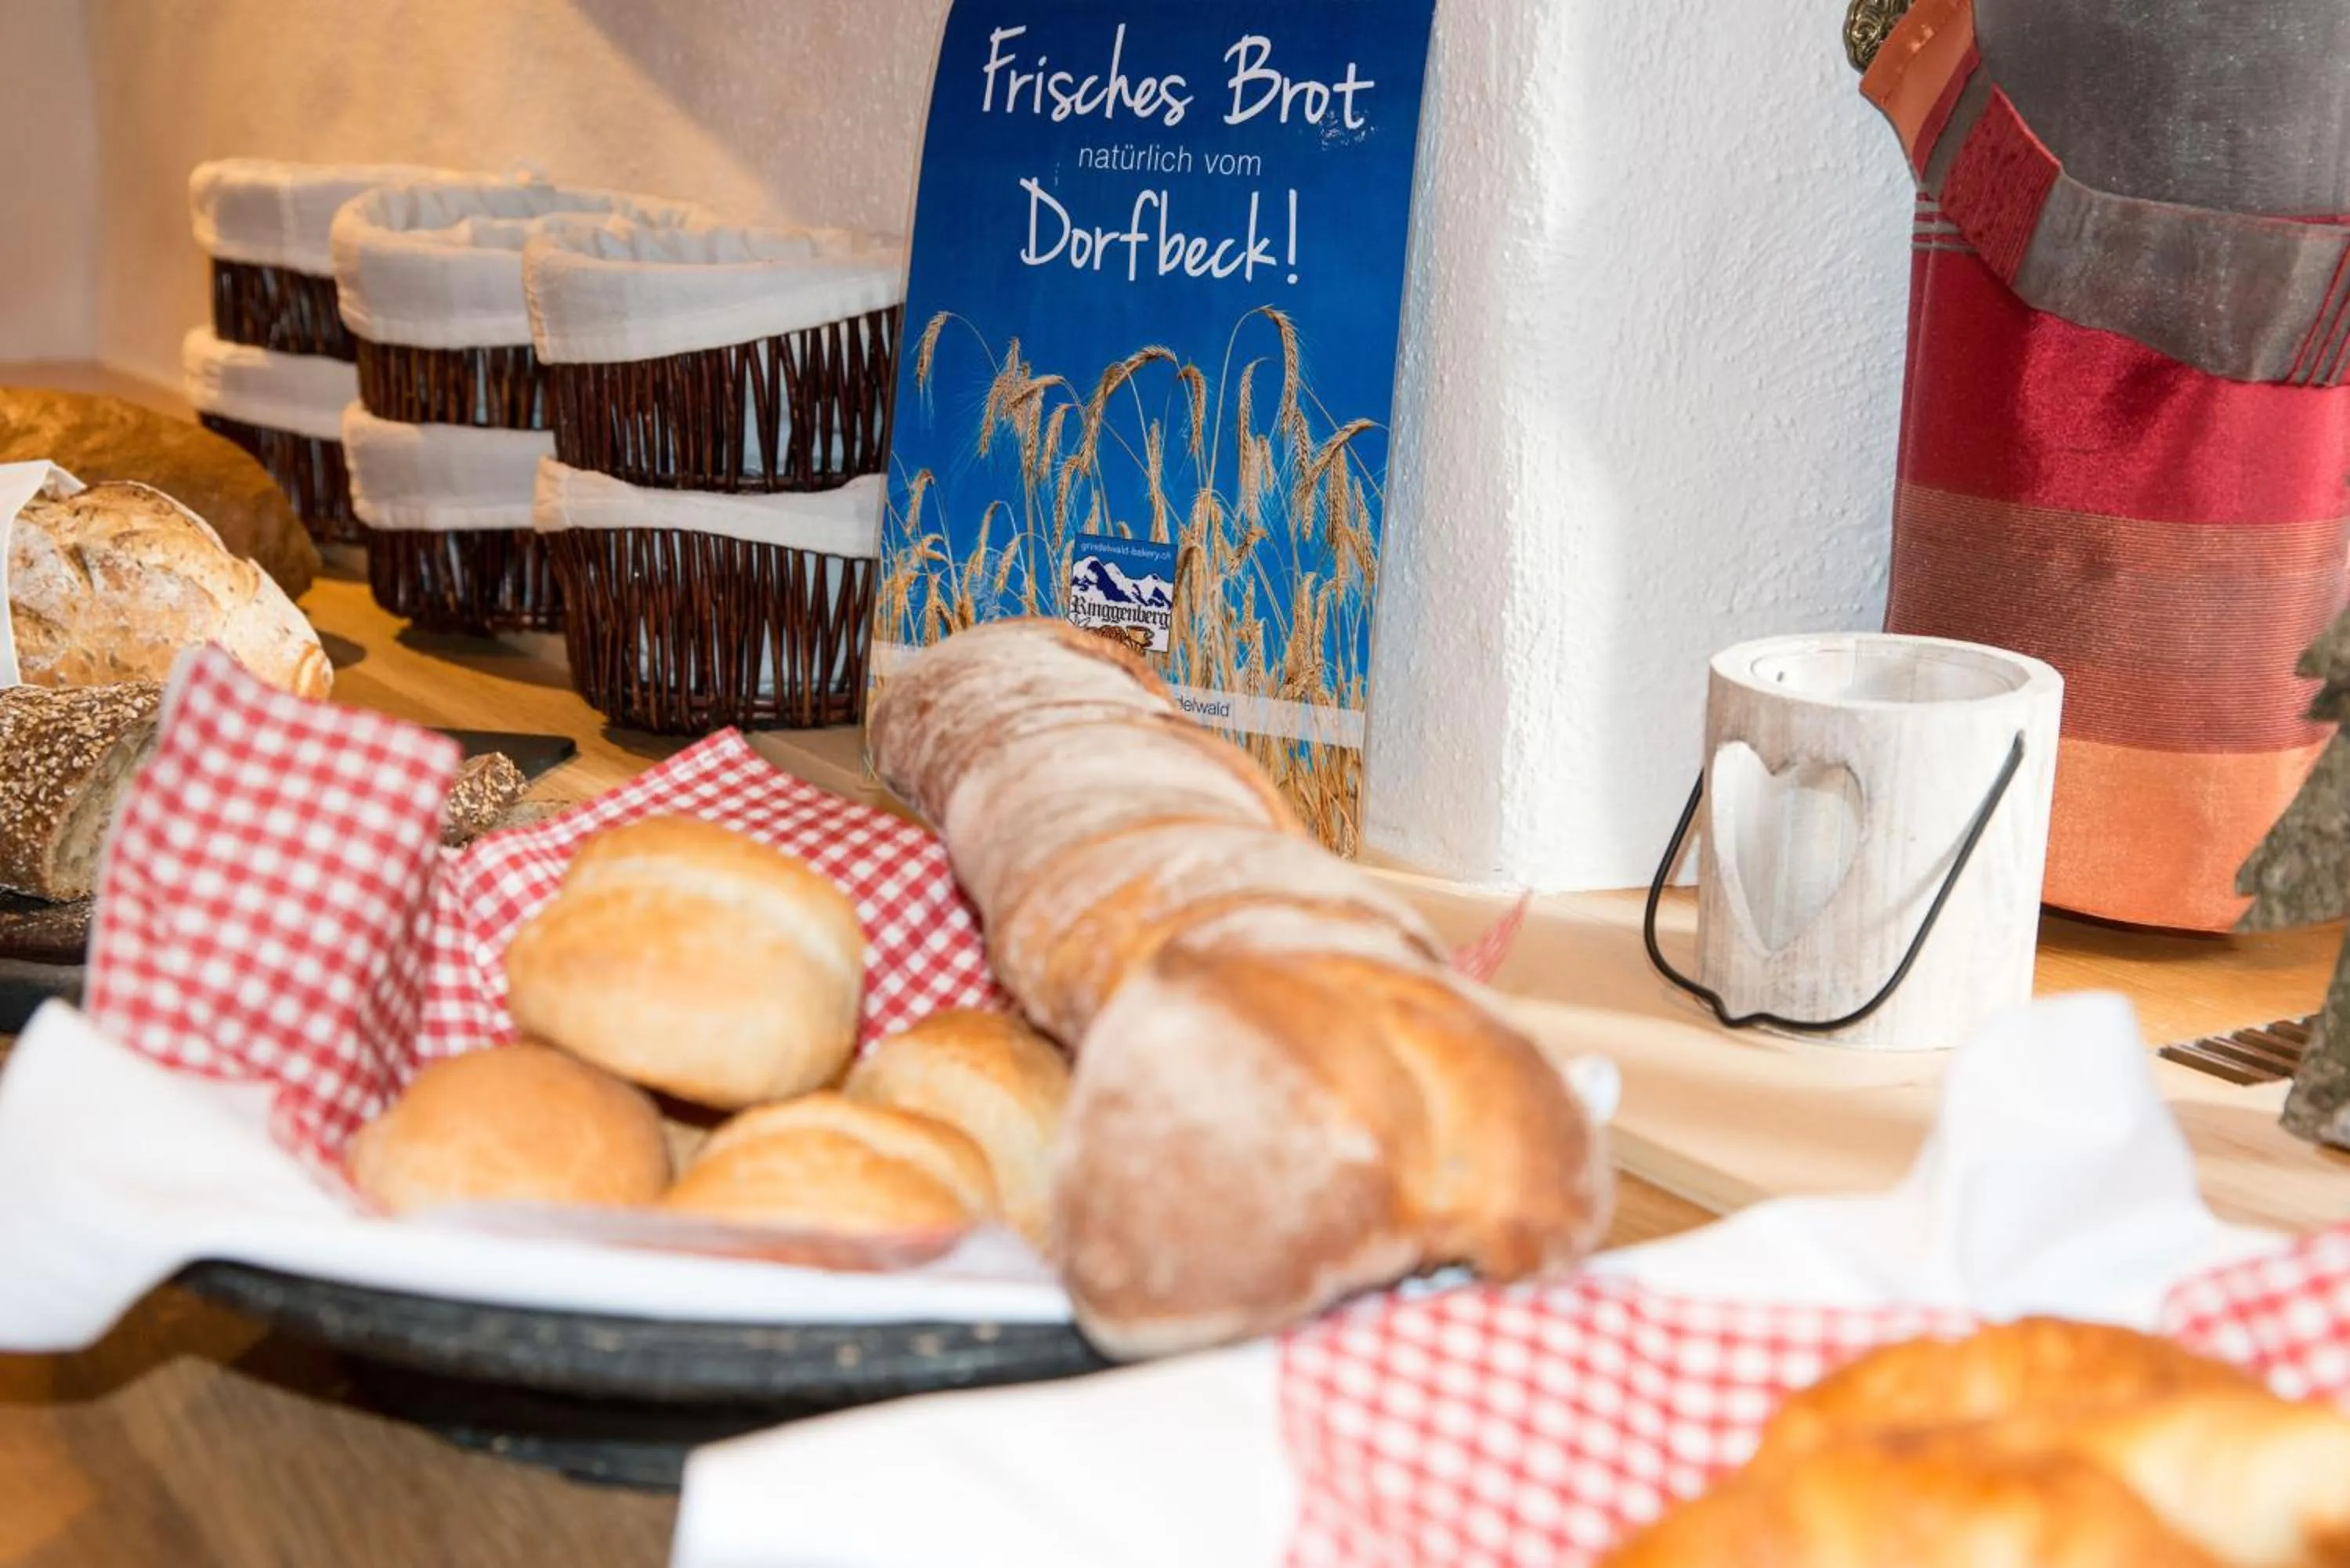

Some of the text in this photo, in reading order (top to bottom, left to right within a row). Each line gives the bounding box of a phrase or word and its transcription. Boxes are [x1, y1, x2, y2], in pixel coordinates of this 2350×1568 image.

[982, 23, 1375, 129] Frisches Brot
[1078, 145, 1262, 176] natürlich vom
[1019, 177, 1298, 284] Dorfbeck!
[1070, 594, 1170, 630] Ringgenberg
